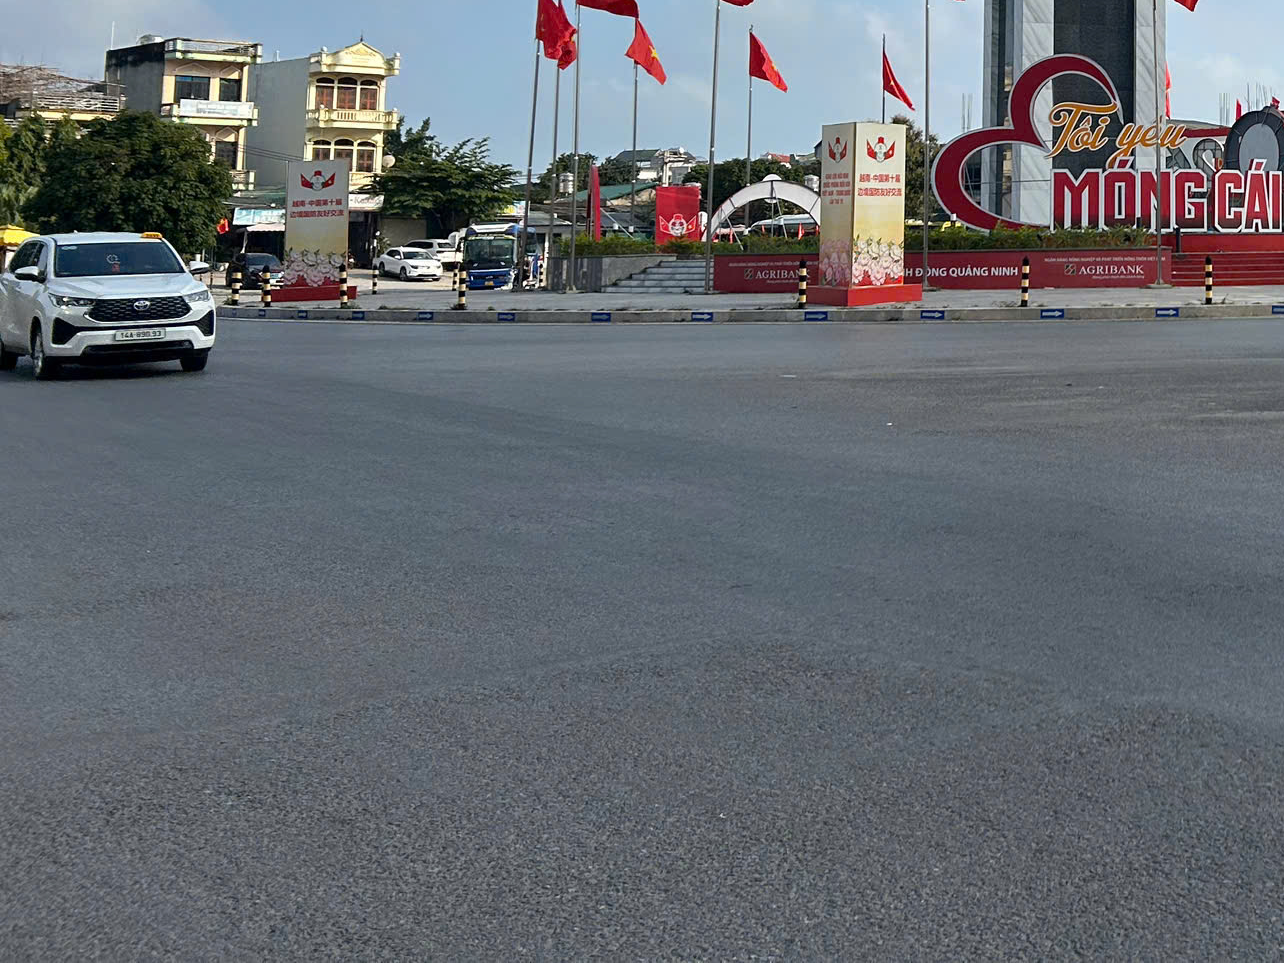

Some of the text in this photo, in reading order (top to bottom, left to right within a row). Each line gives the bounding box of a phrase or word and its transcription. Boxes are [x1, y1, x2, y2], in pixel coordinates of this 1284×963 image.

[1045, 101, 1118, 159] Tôi
[1050, 155, 1208, 233] MÓNG
[1213, 158, 1283, 233] CÁI
[949, 264, 989, 278] QUẢNG
[990, 266, 1019, 276] NINH
[1079, 265, 1144, 275] AGRIBANK
